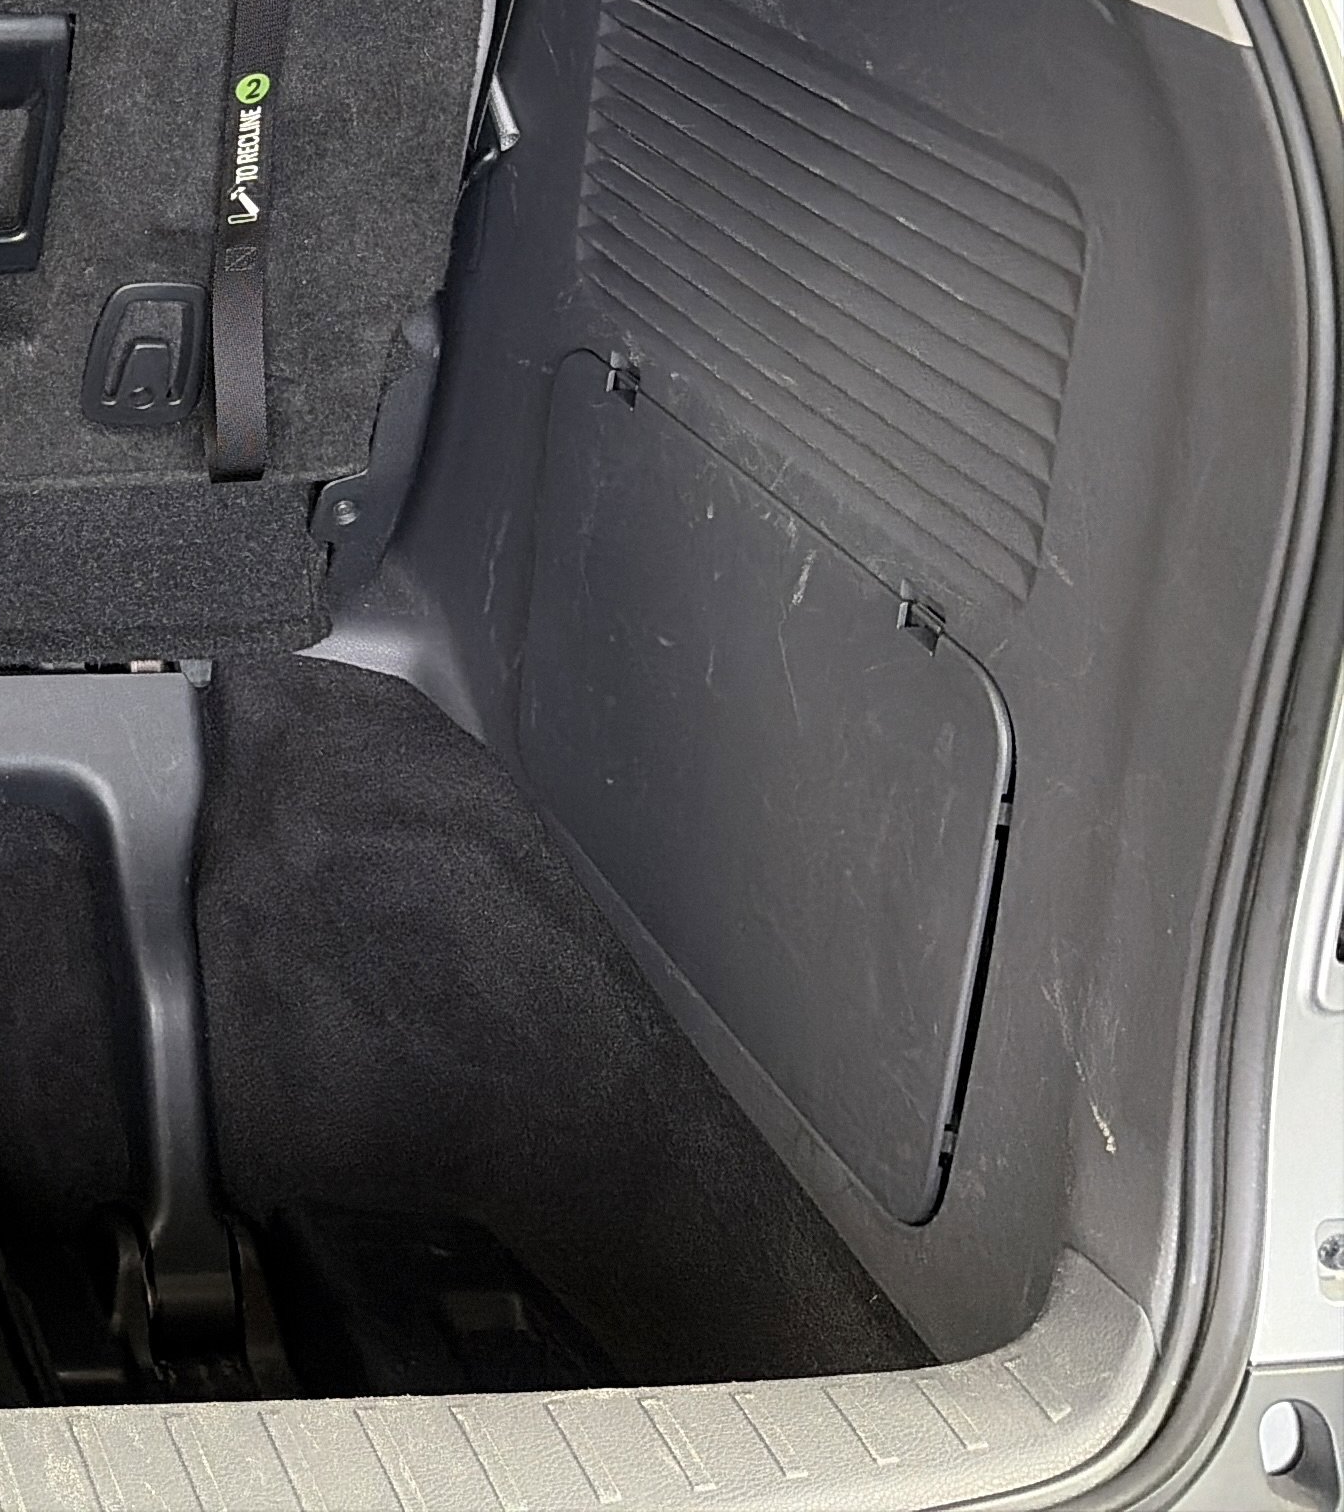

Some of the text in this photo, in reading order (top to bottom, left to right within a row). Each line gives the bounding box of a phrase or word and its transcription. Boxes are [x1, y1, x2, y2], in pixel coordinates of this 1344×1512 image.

[244, 78, 261, 101] 2
[235, 105, 262, 184] TO RECLINE
